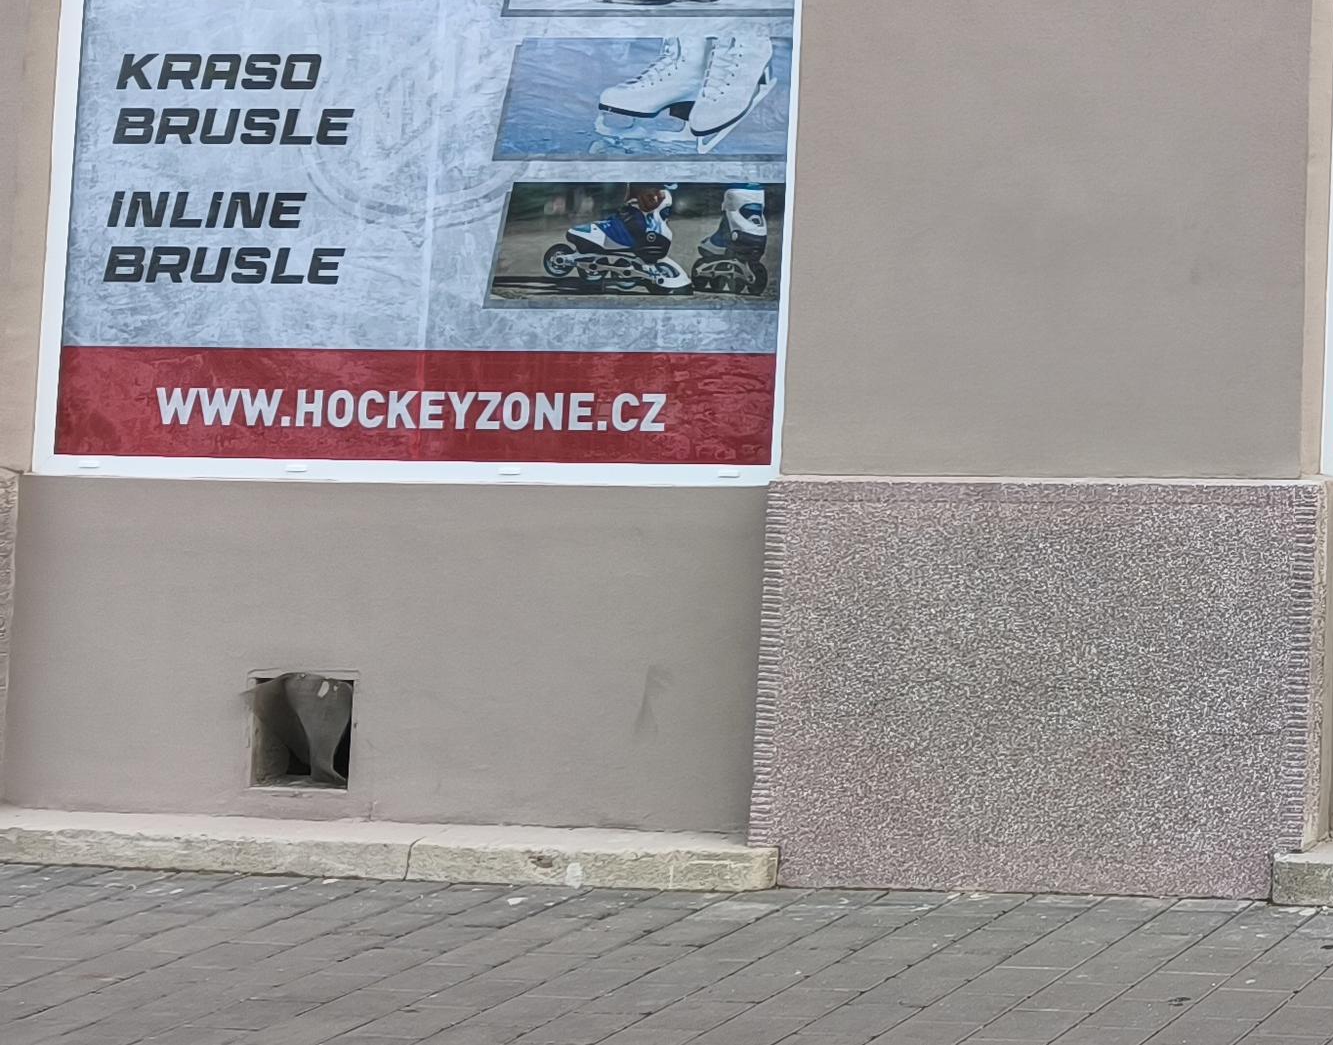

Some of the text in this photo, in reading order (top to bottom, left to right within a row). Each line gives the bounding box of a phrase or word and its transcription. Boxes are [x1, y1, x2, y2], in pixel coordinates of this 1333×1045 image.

[115, 52, 323, 91] KRASO
[112, 107, 355, 146] BRUSLE
[106, 191, 309, 230] INLINE
[102, 246, 347, 286] BRUSLE
[156, 386, 667, 434] WWW.HOCKEYZONE.CZ
